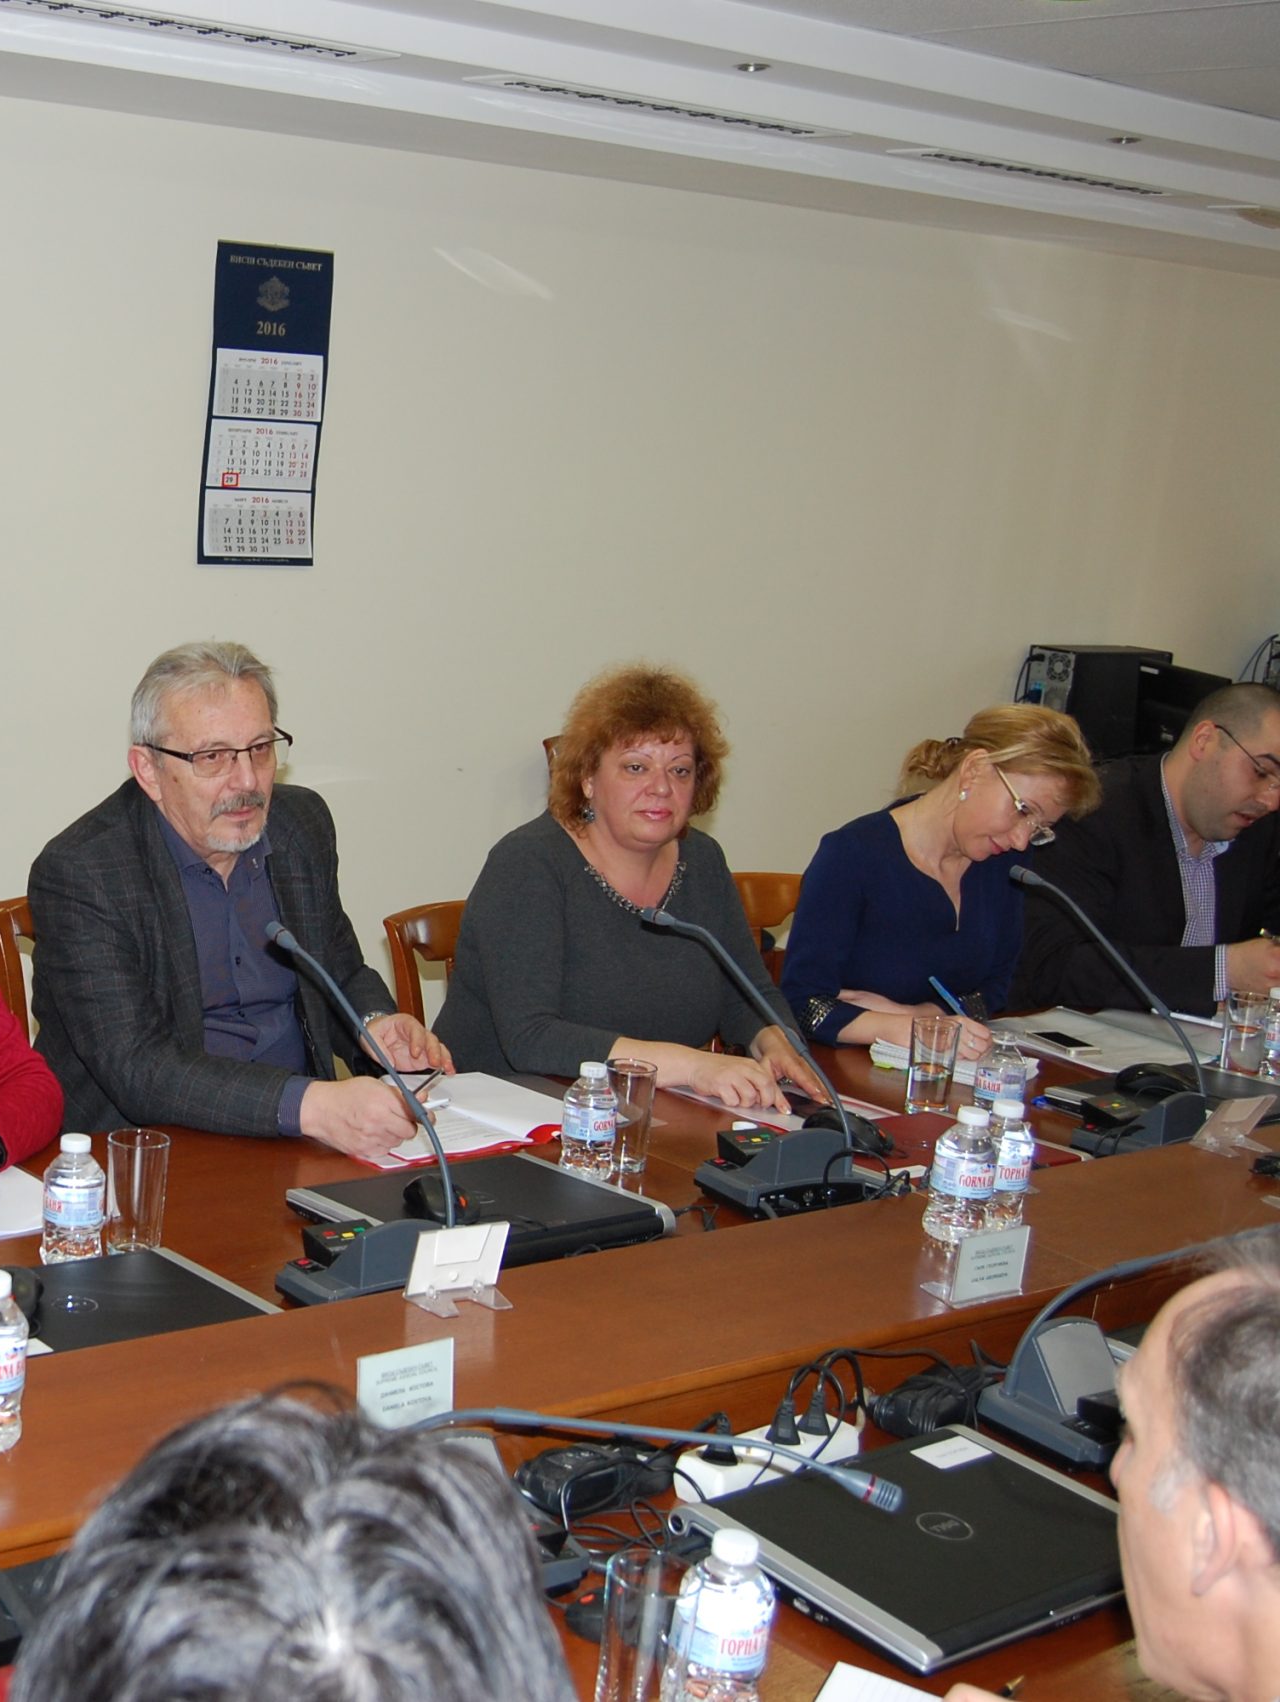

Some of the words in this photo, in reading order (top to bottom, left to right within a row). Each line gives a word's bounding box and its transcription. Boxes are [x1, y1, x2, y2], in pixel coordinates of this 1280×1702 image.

[256, 320, 287, 337] 2016
[261, 357, 278, 365] 2016
[252, 496, 270, 504] 2016
[958, 1174, 986, 1188] GORNA
[720, 1638, 758, 1656] ГОРНА
